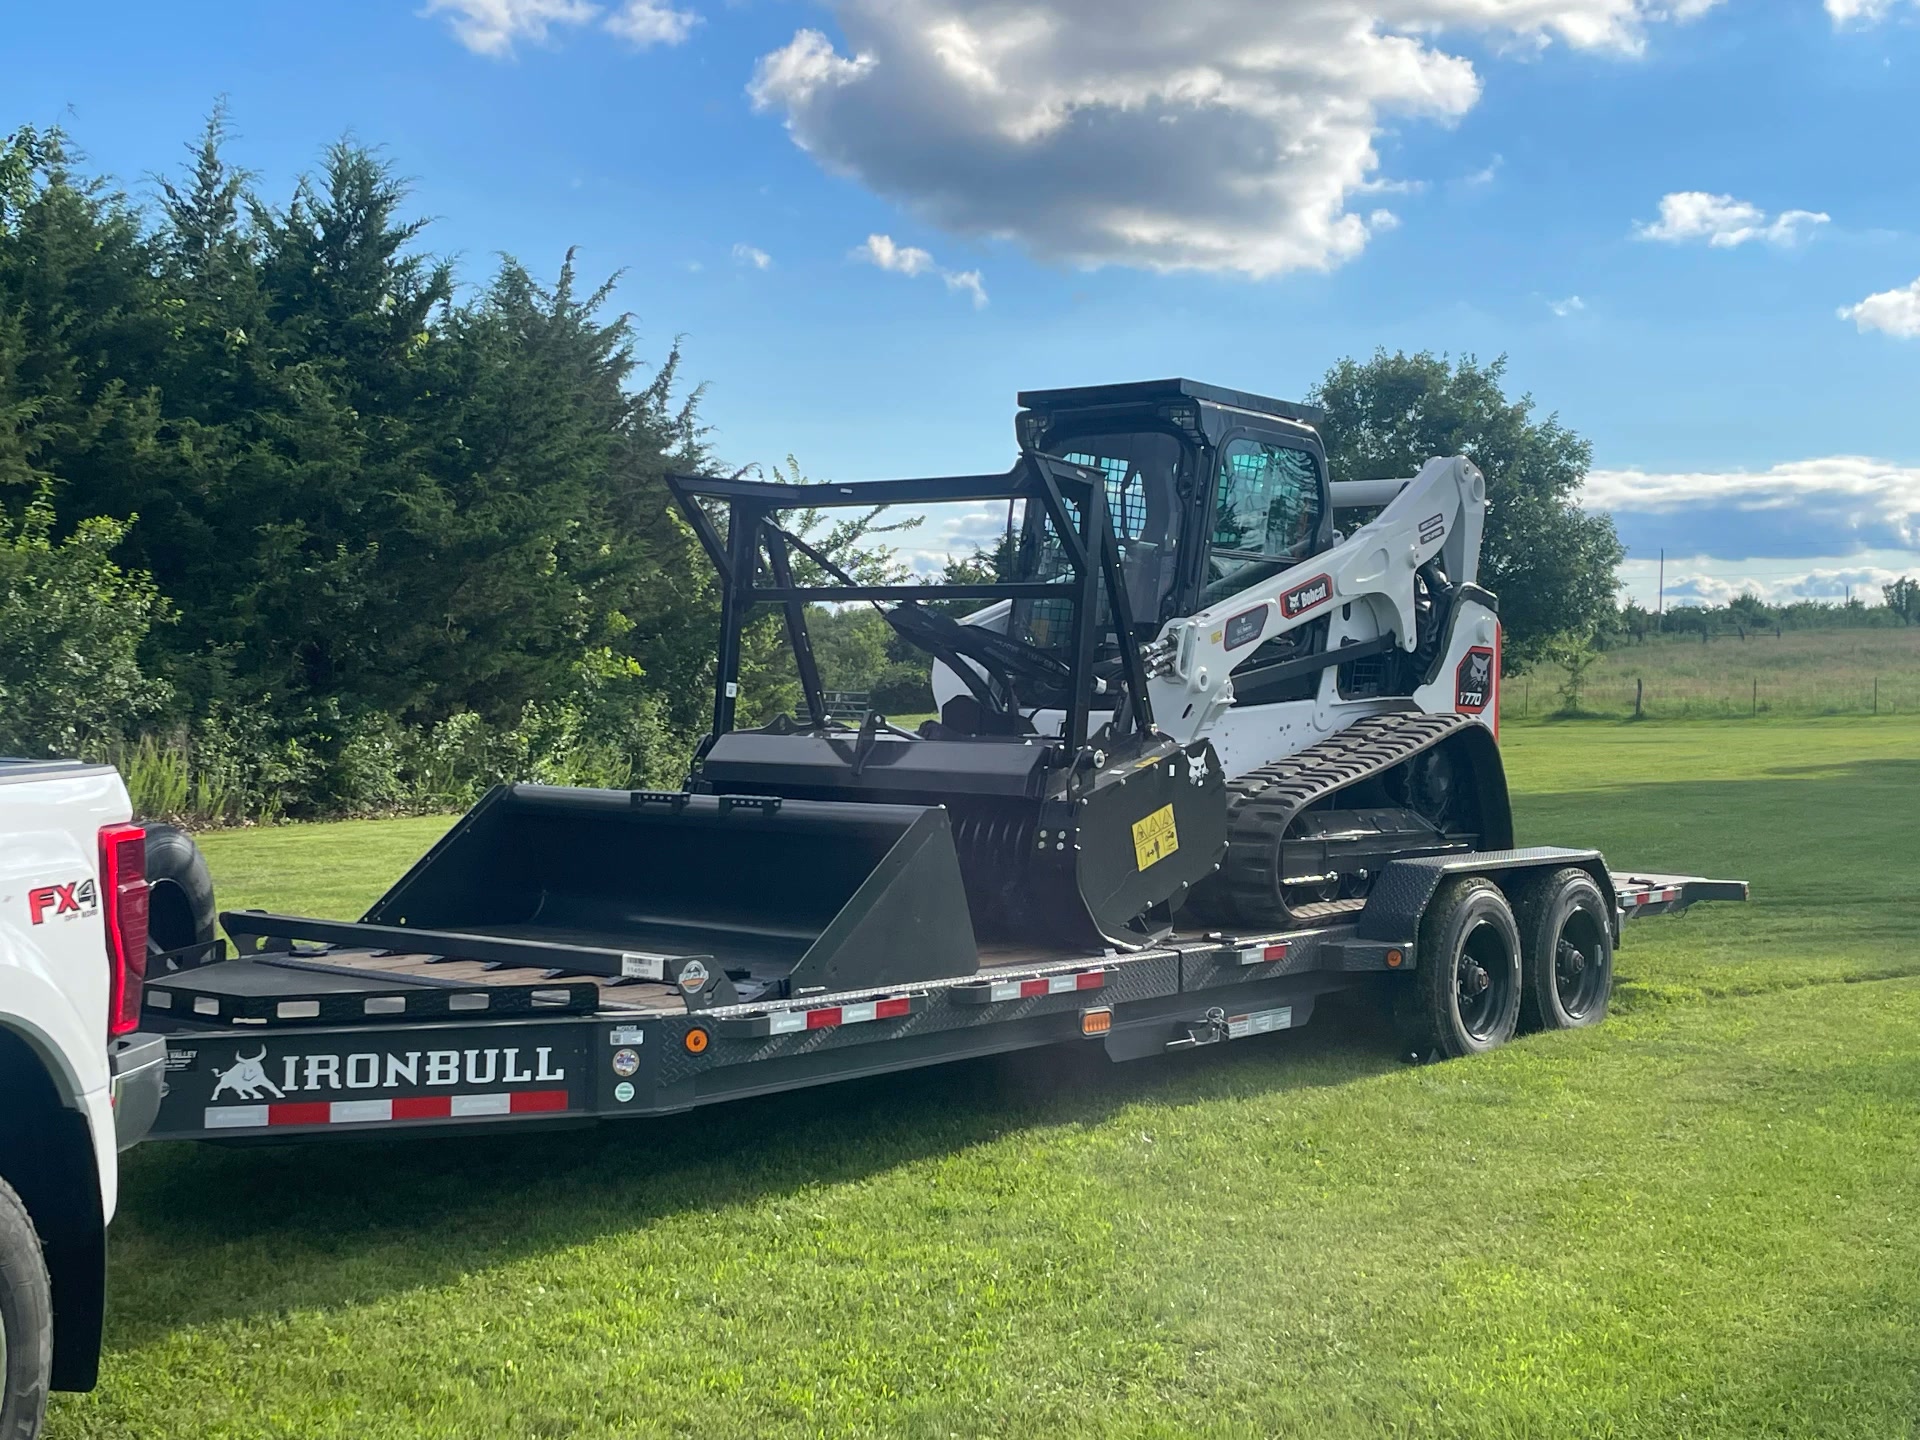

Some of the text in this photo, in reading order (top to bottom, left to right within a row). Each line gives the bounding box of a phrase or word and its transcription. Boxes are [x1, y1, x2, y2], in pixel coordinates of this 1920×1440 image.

[1301, 583, 1327, 608] Bobcat
[1460, 692, 1482, 706] T770
[28, 879, 97, 925] FX4
[281, 1046, 565, 1092] IRONBULL
